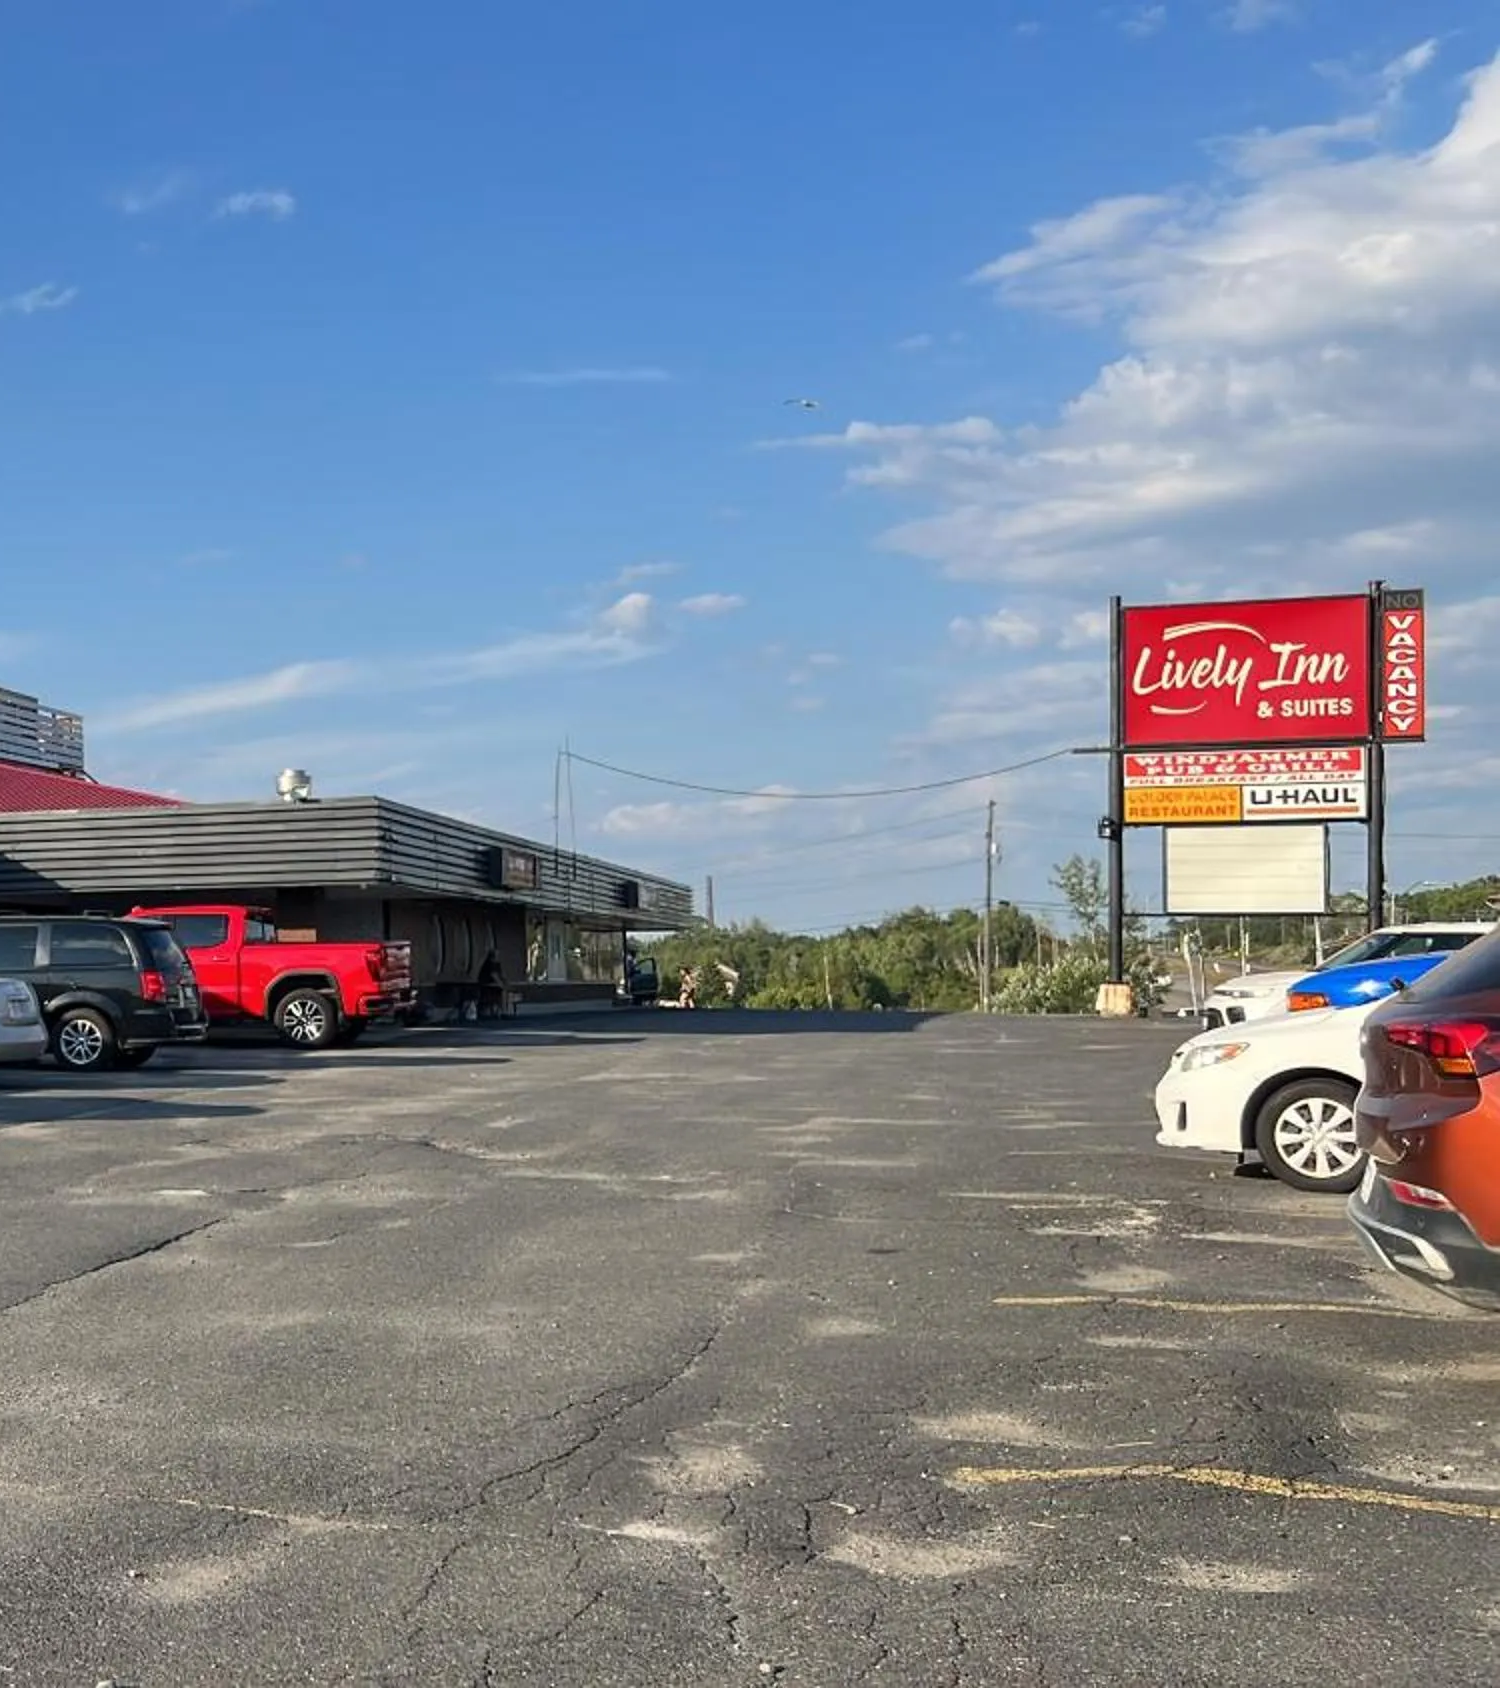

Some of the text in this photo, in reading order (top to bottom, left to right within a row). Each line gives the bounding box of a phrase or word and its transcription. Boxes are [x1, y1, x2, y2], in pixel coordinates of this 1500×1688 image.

[1385, 593, 1418, 609] NO
[1132, 642, 1349, 706] Lively Inn
[1387, 615, 1417, 731] VACANCY
[1257, 698, 1353, 718] & SUITES
[1134, 750, 1351, 767] WINDJAMMER
[1146, 764, 1204, 776] PUB
[1248, 761, 1340, 774] GRILL
[1250, 787, 1357, 805] U-HAUL
[1128, 804, 1237, 818] RESTAURANT
